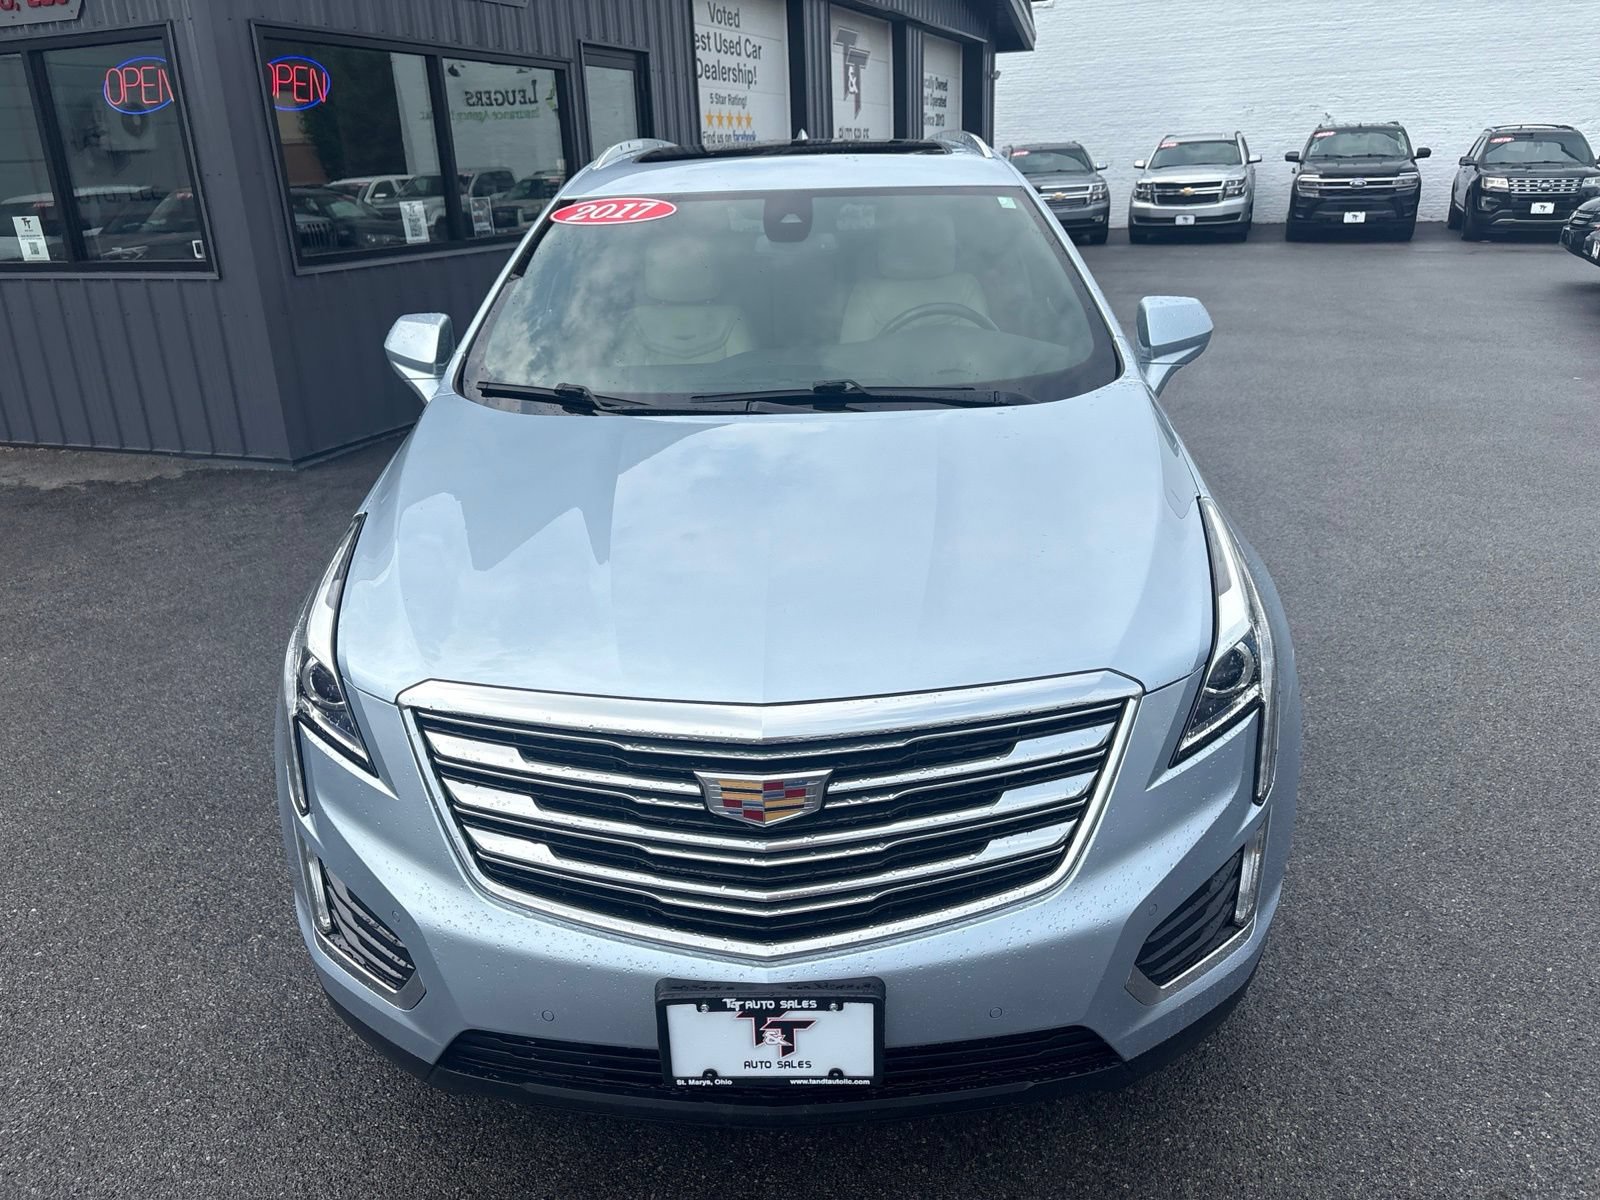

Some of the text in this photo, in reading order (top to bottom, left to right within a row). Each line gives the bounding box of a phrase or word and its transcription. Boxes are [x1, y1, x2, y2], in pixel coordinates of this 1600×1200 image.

[708, 1, 740, 28] Voted
[695, 31, 762, 60] est Used Car
[105, 66, 174, 105] OPEN
[267, 64, 326, 103] PEN
[697, 58, 757, 89] Dealership!
[709, 93, 715, 105] 5
[715, 93, 727, 106] Star
[565, 201, 661, 221] 2017
[745, 999, 775, 1010] AUTO
[780, 999, 818, 1010] SALES
[735, 1010, 818, 1059] T&T
[743, 1060, 812, 1070] AUTO SALES
